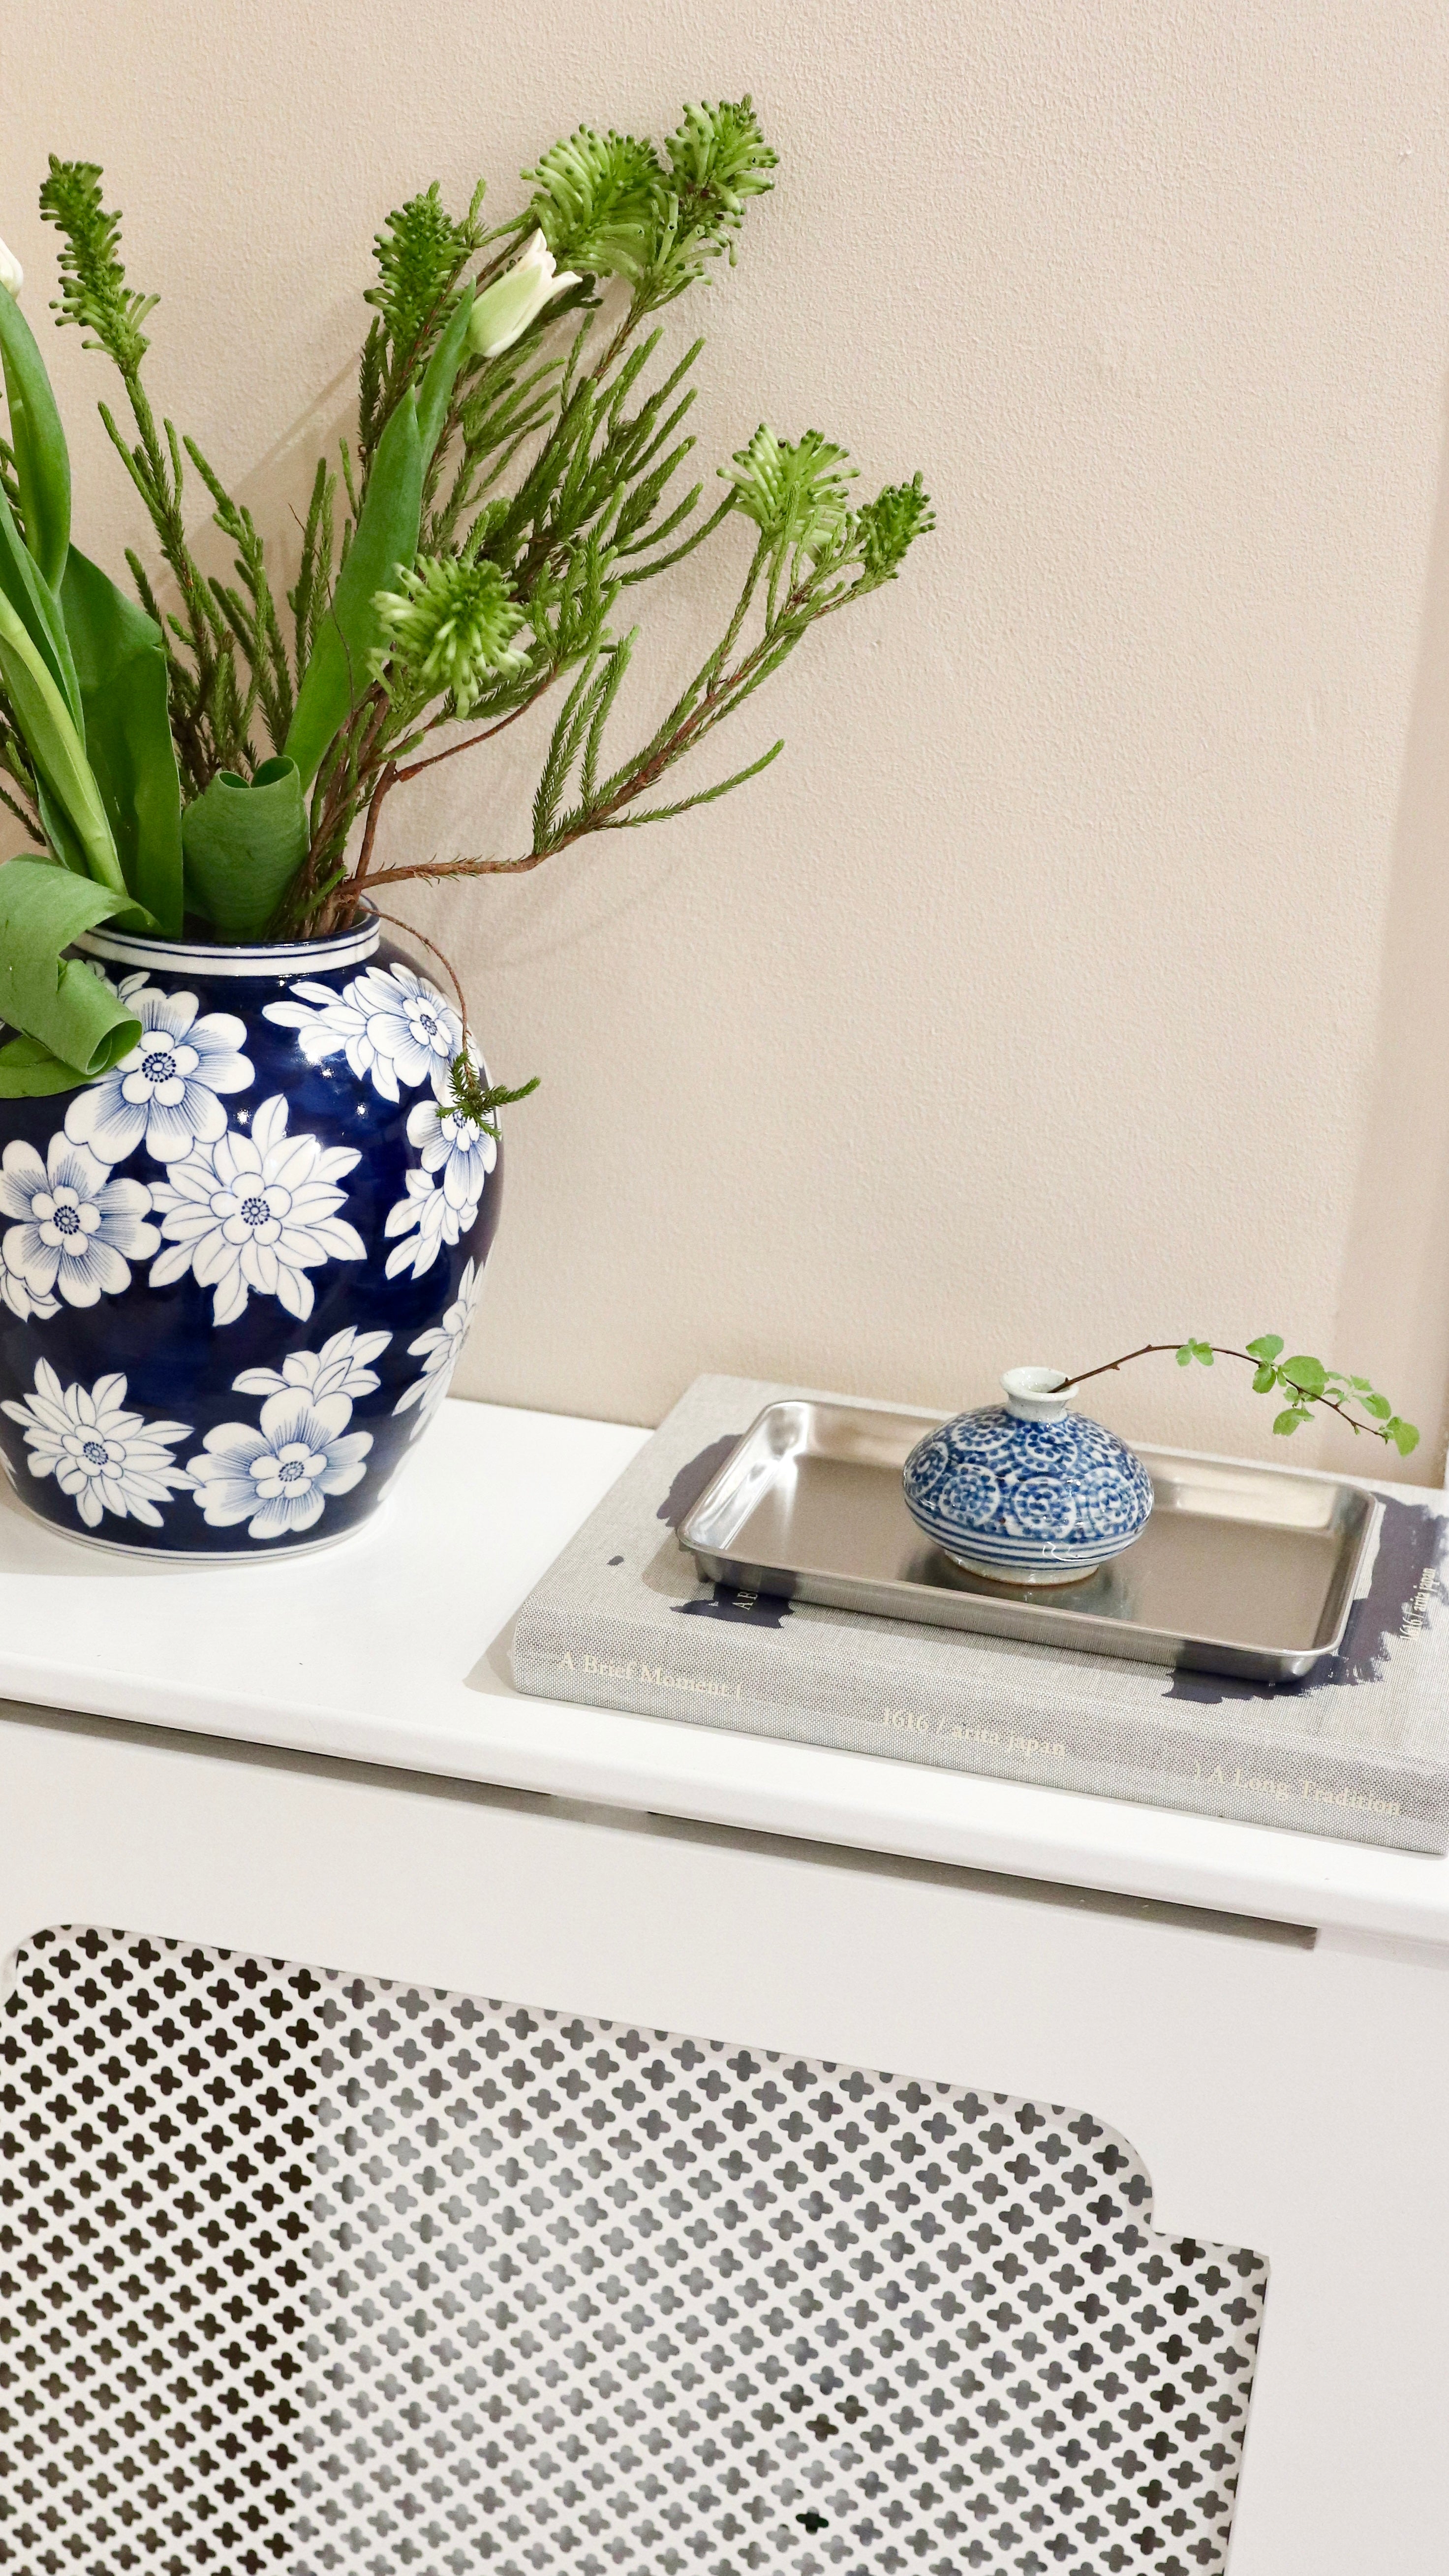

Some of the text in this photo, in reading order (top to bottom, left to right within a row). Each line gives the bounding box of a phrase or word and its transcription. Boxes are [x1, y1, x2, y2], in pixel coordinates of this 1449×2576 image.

[1413, 1567, 1440, 1593] japan
[1410, 1592, 1427, 1613] arita
[1399, 1617, 1422, 1641] 1616
[559, 1651, 575, 1671] A
[584, 1654, 638, 1680] Brief
[640, 1664, 732, 1697] Moment
[884, 1707, 929, 1733] 1616
[952, 1723, 999, 1745] arita
[1006, 1729, 1066, 1757] japan
[1208, 1764, 1226, 1784] A
[1233, 1768, 1289, 1802] Long
[1302, 1779, 1402, 1817] Tradition
